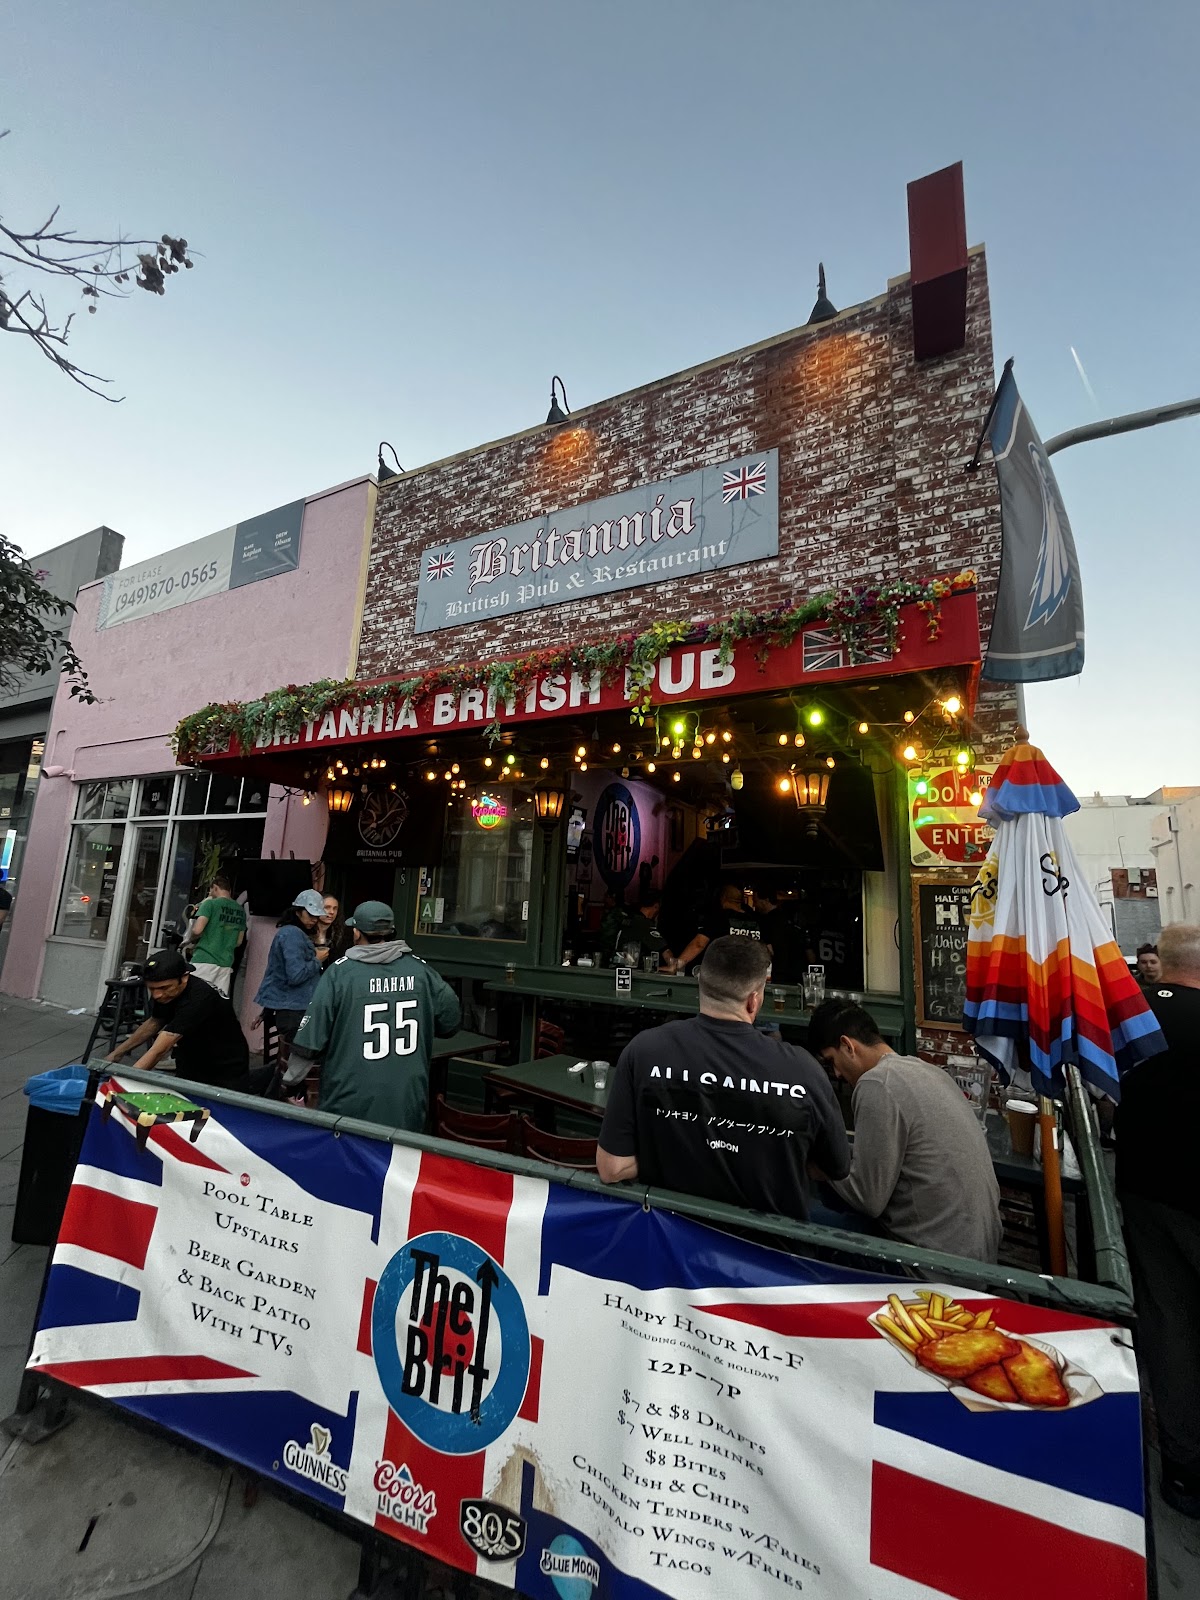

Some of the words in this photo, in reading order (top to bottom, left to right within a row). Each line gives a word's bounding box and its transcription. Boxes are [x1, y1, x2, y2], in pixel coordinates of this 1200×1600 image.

[467, 494, 696, 594] Britannia
[115, 560, 217, 613] (949)870-0565
[118, 576, 135, 590] FOR
[137, 565, 162, 583] LEASE
[445, 590, 510, 620] British
[516, 578, 560, 605] Pub
[565, 572, 586, 591] &
[592, 539, 728, 585] Restaurant
[255, 698, 419, 748] BRTANNIA
[623, 648, 736, 700] PUB
[927, 786, 954, 803] DO
[356, 849, 387, 857] BRITANNIA
[388, 850, 403, 858] PUB
[932, 828, 987, 845] ENTE
[422, 902, 432, 918] A
[934, 894, 960, 903] HALF
[961, 895, 970, 904] &
[818, 938, 846, 965] 65
[369, 975, 415, 993] GRAHAM
[362, 999, 419, 1060] 55
[202, 1180, 250, 1208] POOL
[256, 1194, 314, 1227] TABLE
[214, 1211, 300, 1254] UPSTAIRS
[187, 1239, 231, 1271] BEER
[236, 1258, 317, 1301] GARDEN
[410, 1247, 475, 1336] The
[177, 1268, 193, 1287] &
[199, 1274, 246, 1308] BACK
[251, 1294, 311, 1331] PATIO
[191, 1301, 243, 1338] WITH
[602, 1292, 667, 1326] HAPPY
[673, 1313, 738, 1352] HOUR
[744, 1339, 805, 1370] M-F
[620, 1319, 677, 1346] EXCLUDING
[679, 1339, 712, 1360] GAMES
[713, 1355, 725, 1366] &
[727, 1361, 780, 1383] HOLIDAYS
[401, 1310, 490, 1425] Brit
[617, 1409, 636, 1435] $7
[641, 1423, 694, 1446] WELL
[699, 1438, 765, 1477] DRINKS
[621, 1388, 641, 1414] $7
[645, 1402, 663, 1417] &
[669, 1404, 691, 1421] $8
[696, 1410, 767, 1456] DRAFTS
[285, 1443, 347, 1492] GUINNESS
[373, 1460, 435, 1515] Coors
[621, 1461, 663, 1492] FISH
[668, 1479, 687, 1494] &
[692, 1483, 750, 1515] CHIPS
[645, 1449, 667, 1467] $8
[673, 1454, 727, 1482] BITES
[377, 1493, 428, 1531] LIGHT
[572, 1454, 641, 1511] CHICKEN
[646, 1499, 734, 1533] TENDERS
[579, 1480, 646, 1538] BUFFALO
[651, 1525, 716, 1553] WINGS
[463, 1506, 522, 1551] 805
[541, 1551, 571, 1574] BLUE
[571, 1557, 599, 1583] MOON
[649, 1550, 713, 1577] TACOS
